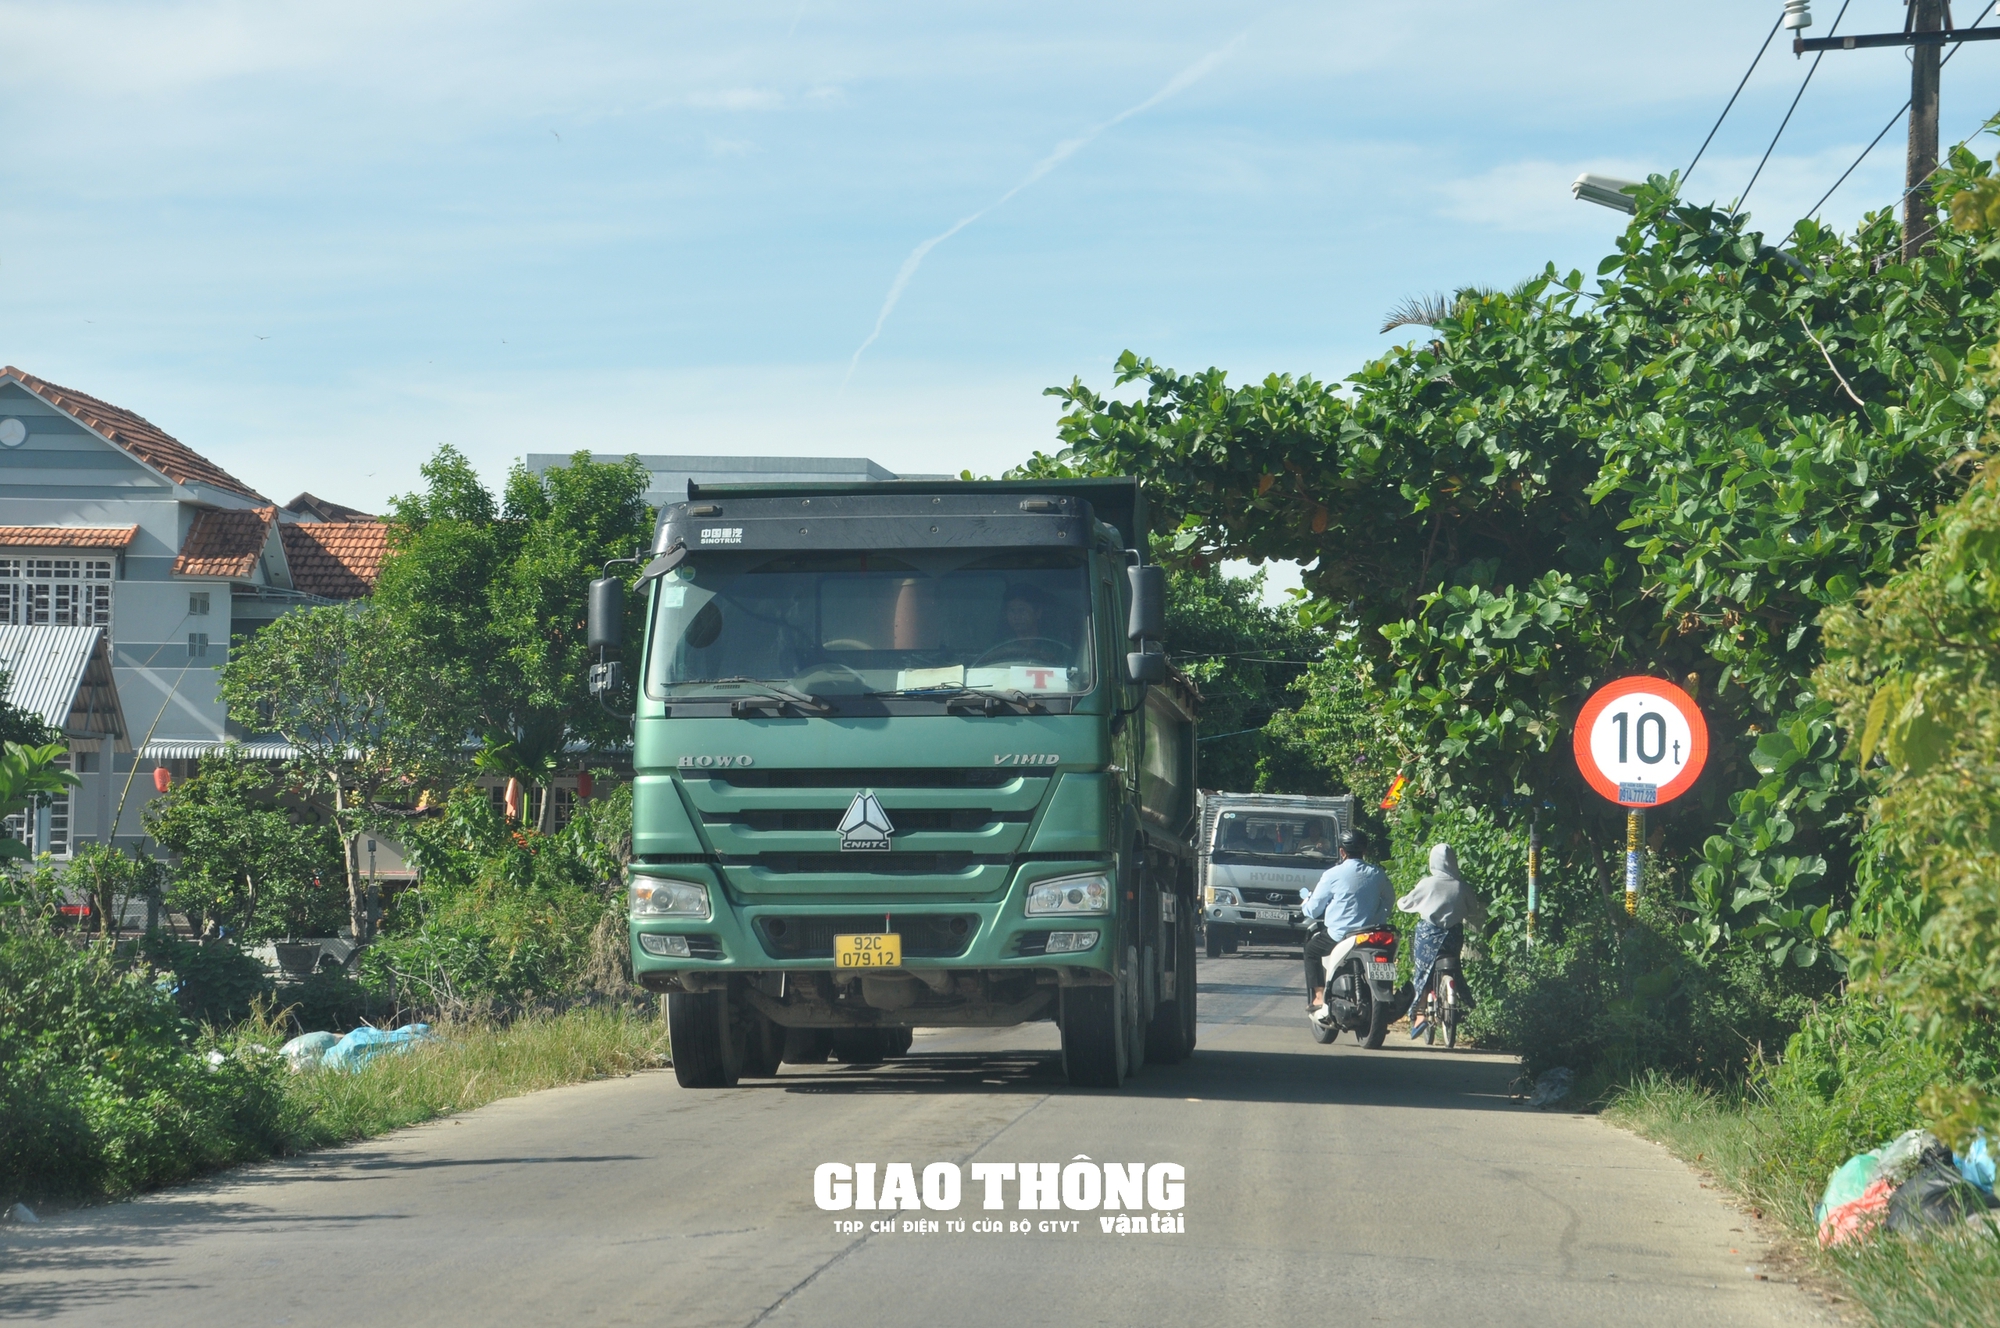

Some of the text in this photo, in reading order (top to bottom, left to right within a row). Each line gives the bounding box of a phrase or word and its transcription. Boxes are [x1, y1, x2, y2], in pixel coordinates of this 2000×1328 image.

[1026, 670, 1054, 689] T
[1612, 711, 1681, 765] 10 t
[678, 755, 754, 767] HOWO
[994, 754, 1060, 765] VIMID
[844, 840, 887, 848] CNHTC
[1250, 872, 1306, 883] HYUNDAI
[854, 936, 882, 951] 92C
[843, 952, 894, 966] 079.12
